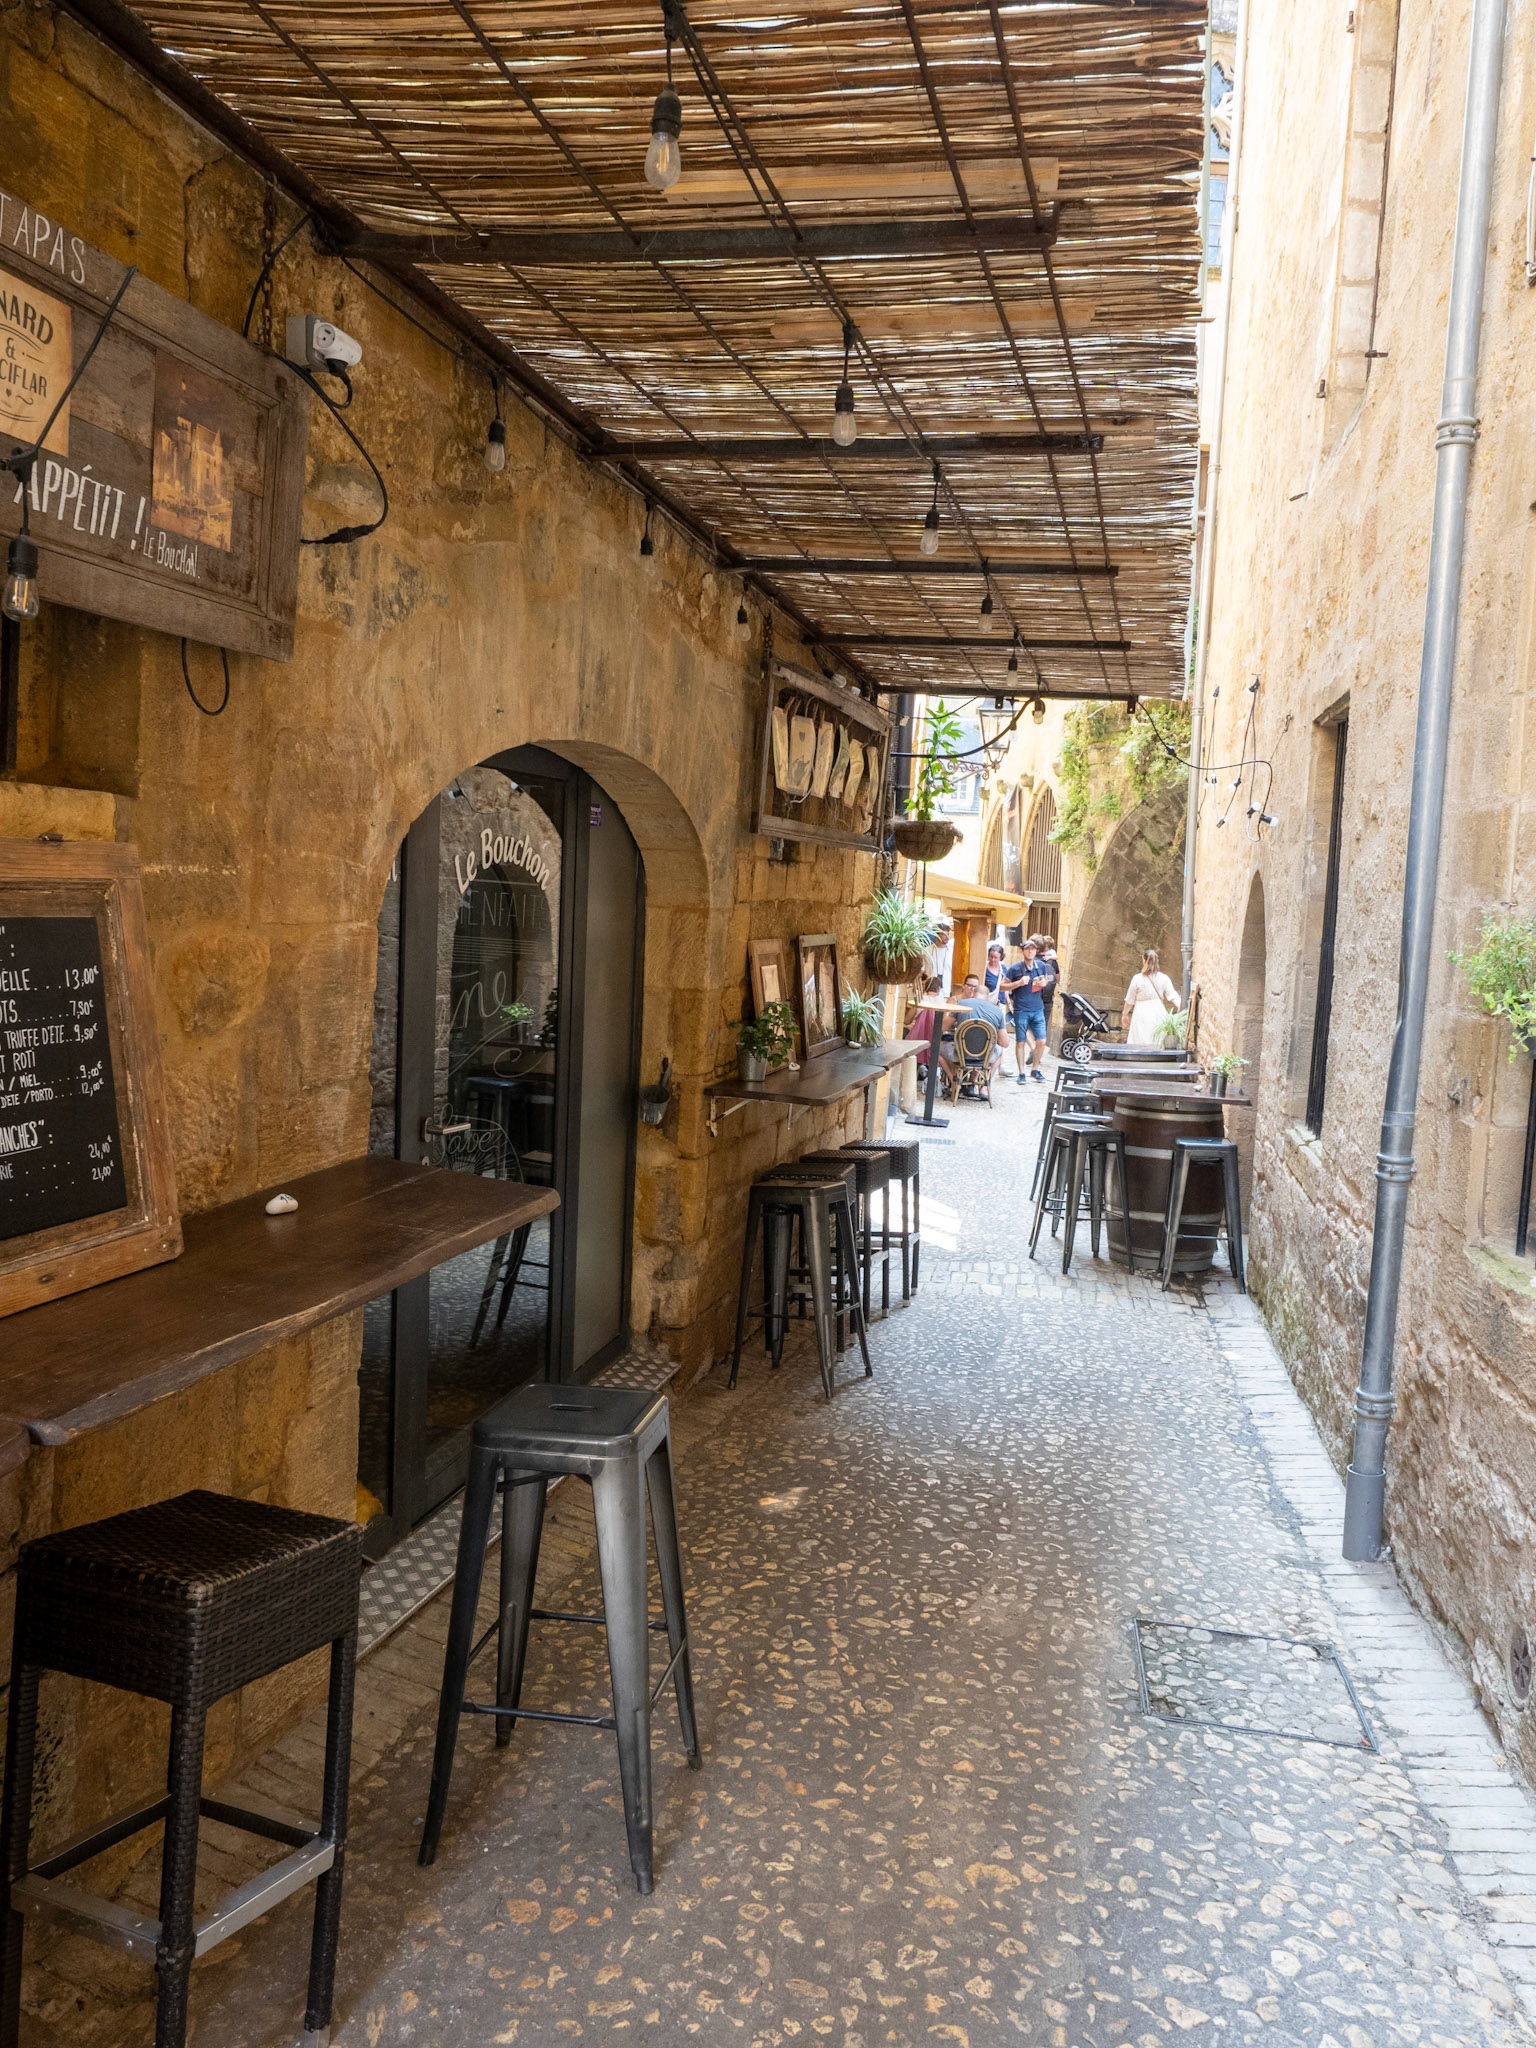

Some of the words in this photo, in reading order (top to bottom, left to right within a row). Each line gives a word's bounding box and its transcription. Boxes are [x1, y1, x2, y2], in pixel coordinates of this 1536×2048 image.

[0, 192, 85, 284] TAPAS
[5, 336, 16, 361] &
[143, 527, 156, 559] LE
[454, 850, 478, 894] Le
[480, 827, 551, 891] Bouchon
[3, 1027, 40, 1050] TRUFFE
